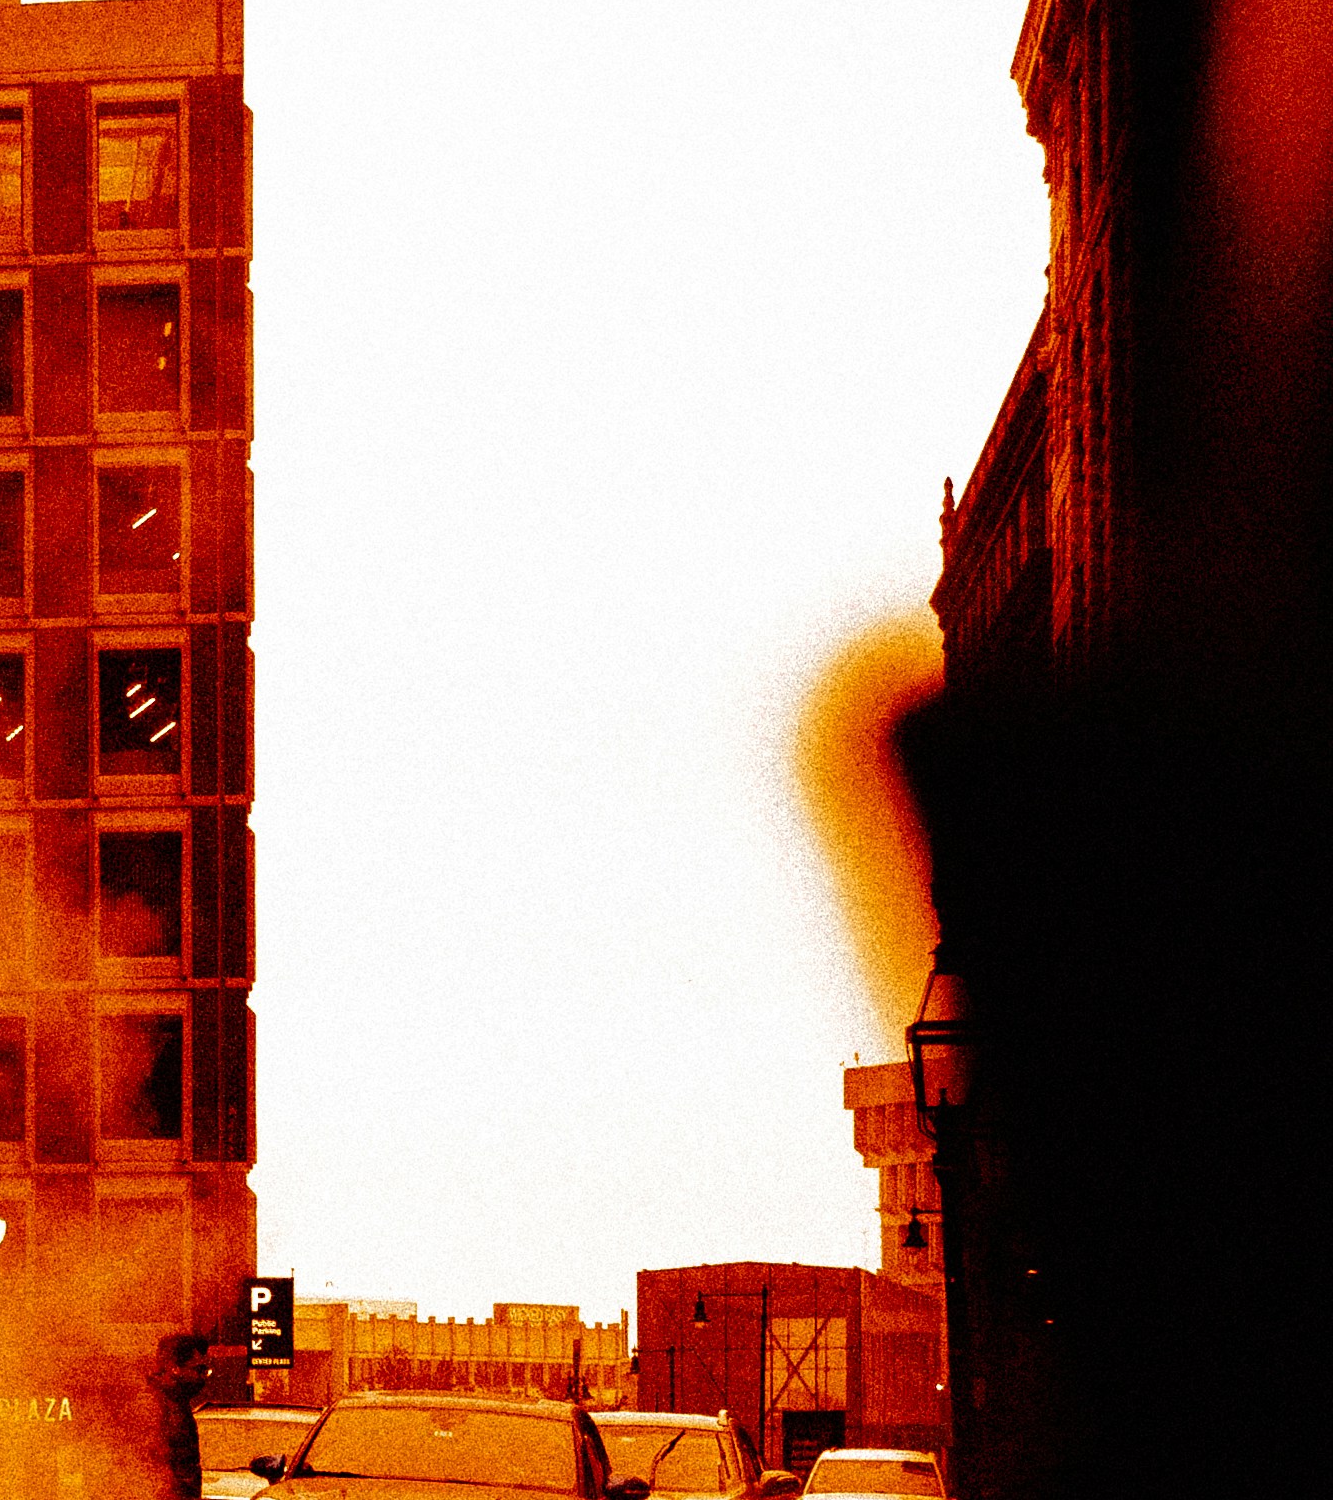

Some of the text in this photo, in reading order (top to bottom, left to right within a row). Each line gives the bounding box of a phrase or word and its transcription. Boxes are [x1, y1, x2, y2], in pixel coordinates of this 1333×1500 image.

[251, 1287, 272, 1312] P
[251, 1319, 276, 1328] Public
[251, 1327, 281, 1336] Parking
